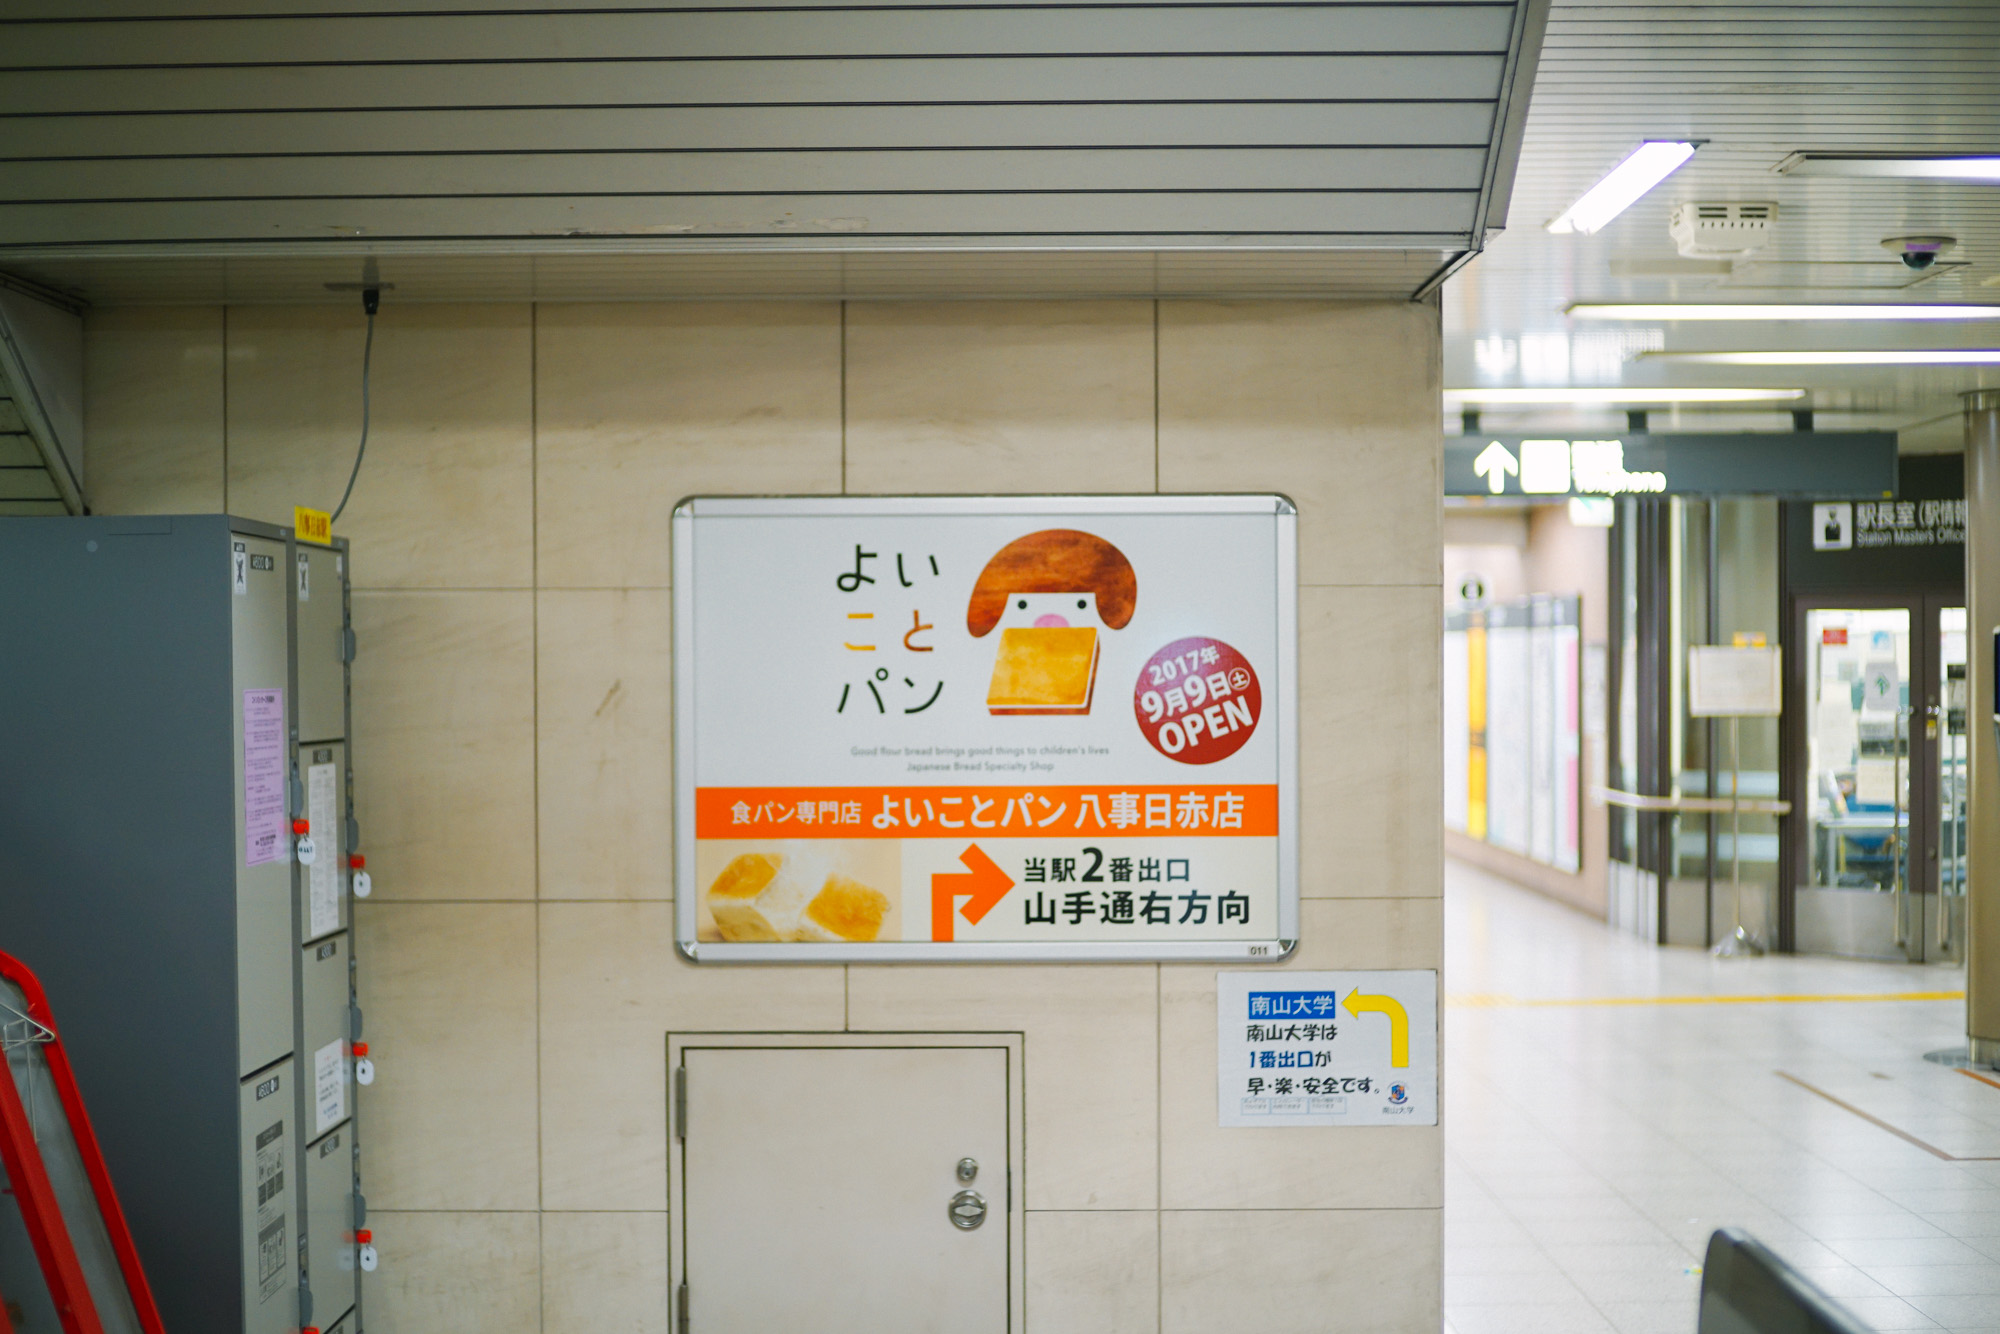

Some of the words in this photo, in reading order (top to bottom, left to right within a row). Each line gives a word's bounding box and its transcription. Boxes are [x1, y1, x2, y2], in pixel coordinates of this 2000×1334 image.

[837, 544, 939, 592] よい
[843, 608, 934, 652] こと
[1148, 645, 1220, 686] 2017年
[837, 667, 944, 714] パン
[1158, 695, 1254, 754] OPEN
[850, 746, 878, 756] Good
[880, 746, 901, 756] flour
[904, 746, 933, 756] bread
[935, 746, 965, 757] brings
[967, 746, 993, 758] good
[996, 746, 1024, 757] things
[1027, 746, 1037, 755] to
[1040, 745, 1085, 755] children's
[1087, 744, 1109, 754] lives
[907, 763, 951, 772] Japanese
[954, 762, 982, 771] Bread
[985, 761, 1027, 772] Specialty
[1029, 761, 1055, 772] Shop
[730, 800, 862, 825] 食パン専門店
[872, 794, 1067, 830] よいことパン
[1074, 791, 1245, 829] 八事日赤店
[1024, 847, 1191, 883] 当駅2番出口
[1024, 890, 1250, 925] 山手通右方向
[1250, 946, 1268, 955] 011
[1250, 994, 1333, 1016] 南山大学
[1246, 1024, 1338, 1042] 南山大学は
[1249, 1050, 1332, 1069] 1番出口が
[1382, 1105, 1416, 1115] 南山大学
